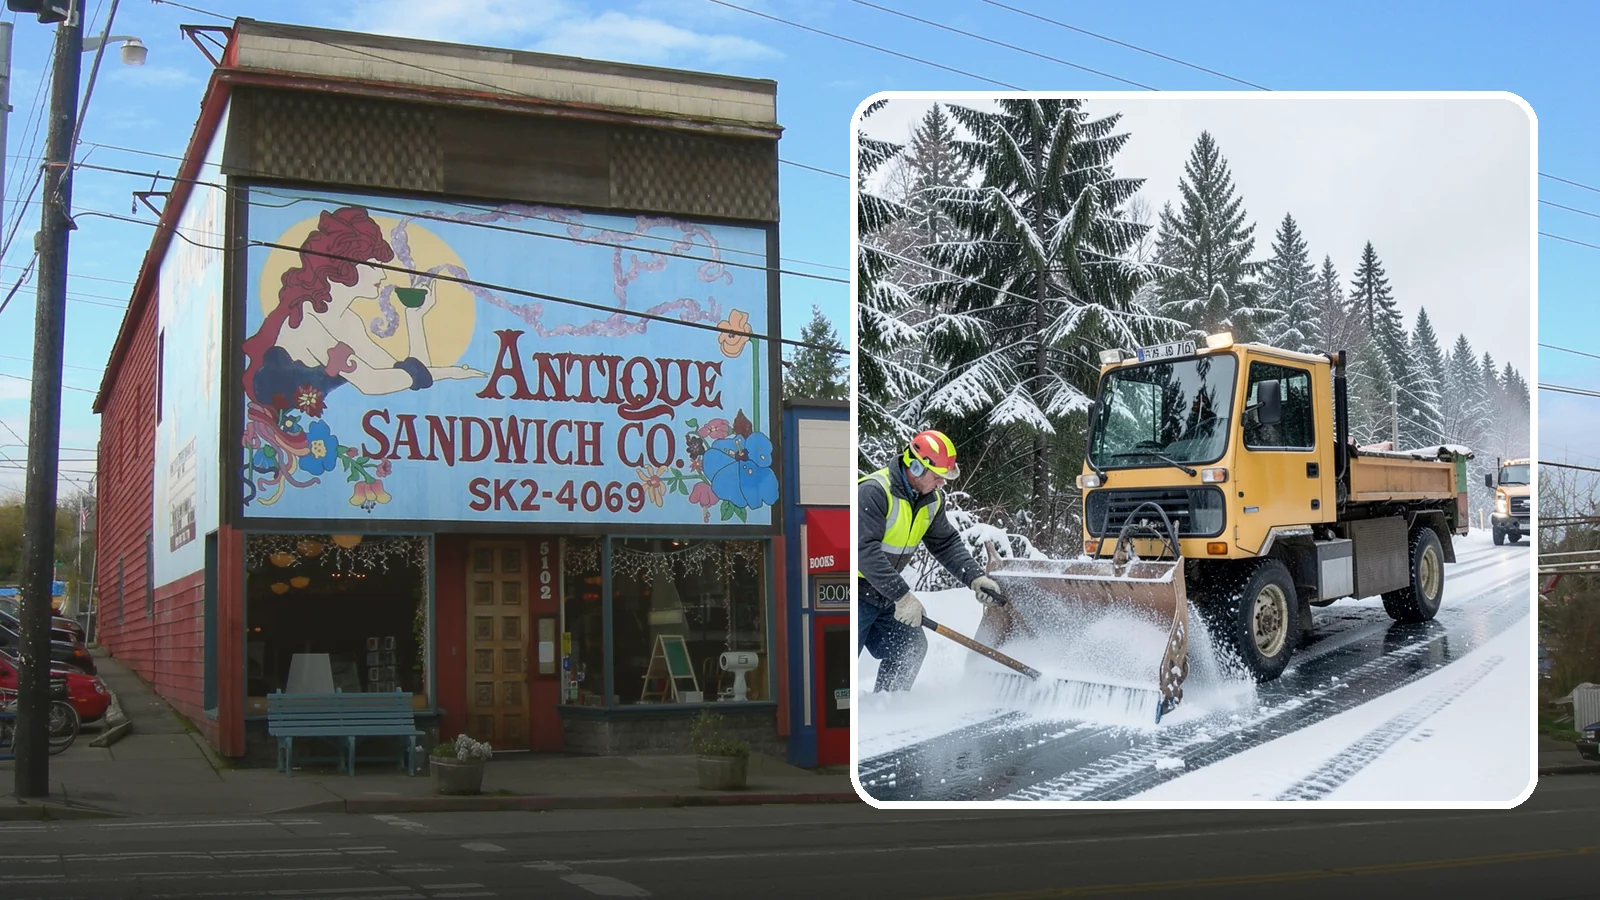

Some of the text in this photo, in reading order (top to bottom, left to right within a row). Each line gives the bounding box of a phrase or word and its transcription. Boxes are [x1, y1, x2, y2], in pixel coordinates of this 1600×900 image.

[476, 328, 723, 421] ANTIQUE
[361, 408, 685, 469] SANDWICH CO.
[468, 477, 646, 513] SK2-4069
[540, 542, 551, 599] 5102
[809, 555, 834, 569] BOOKS
